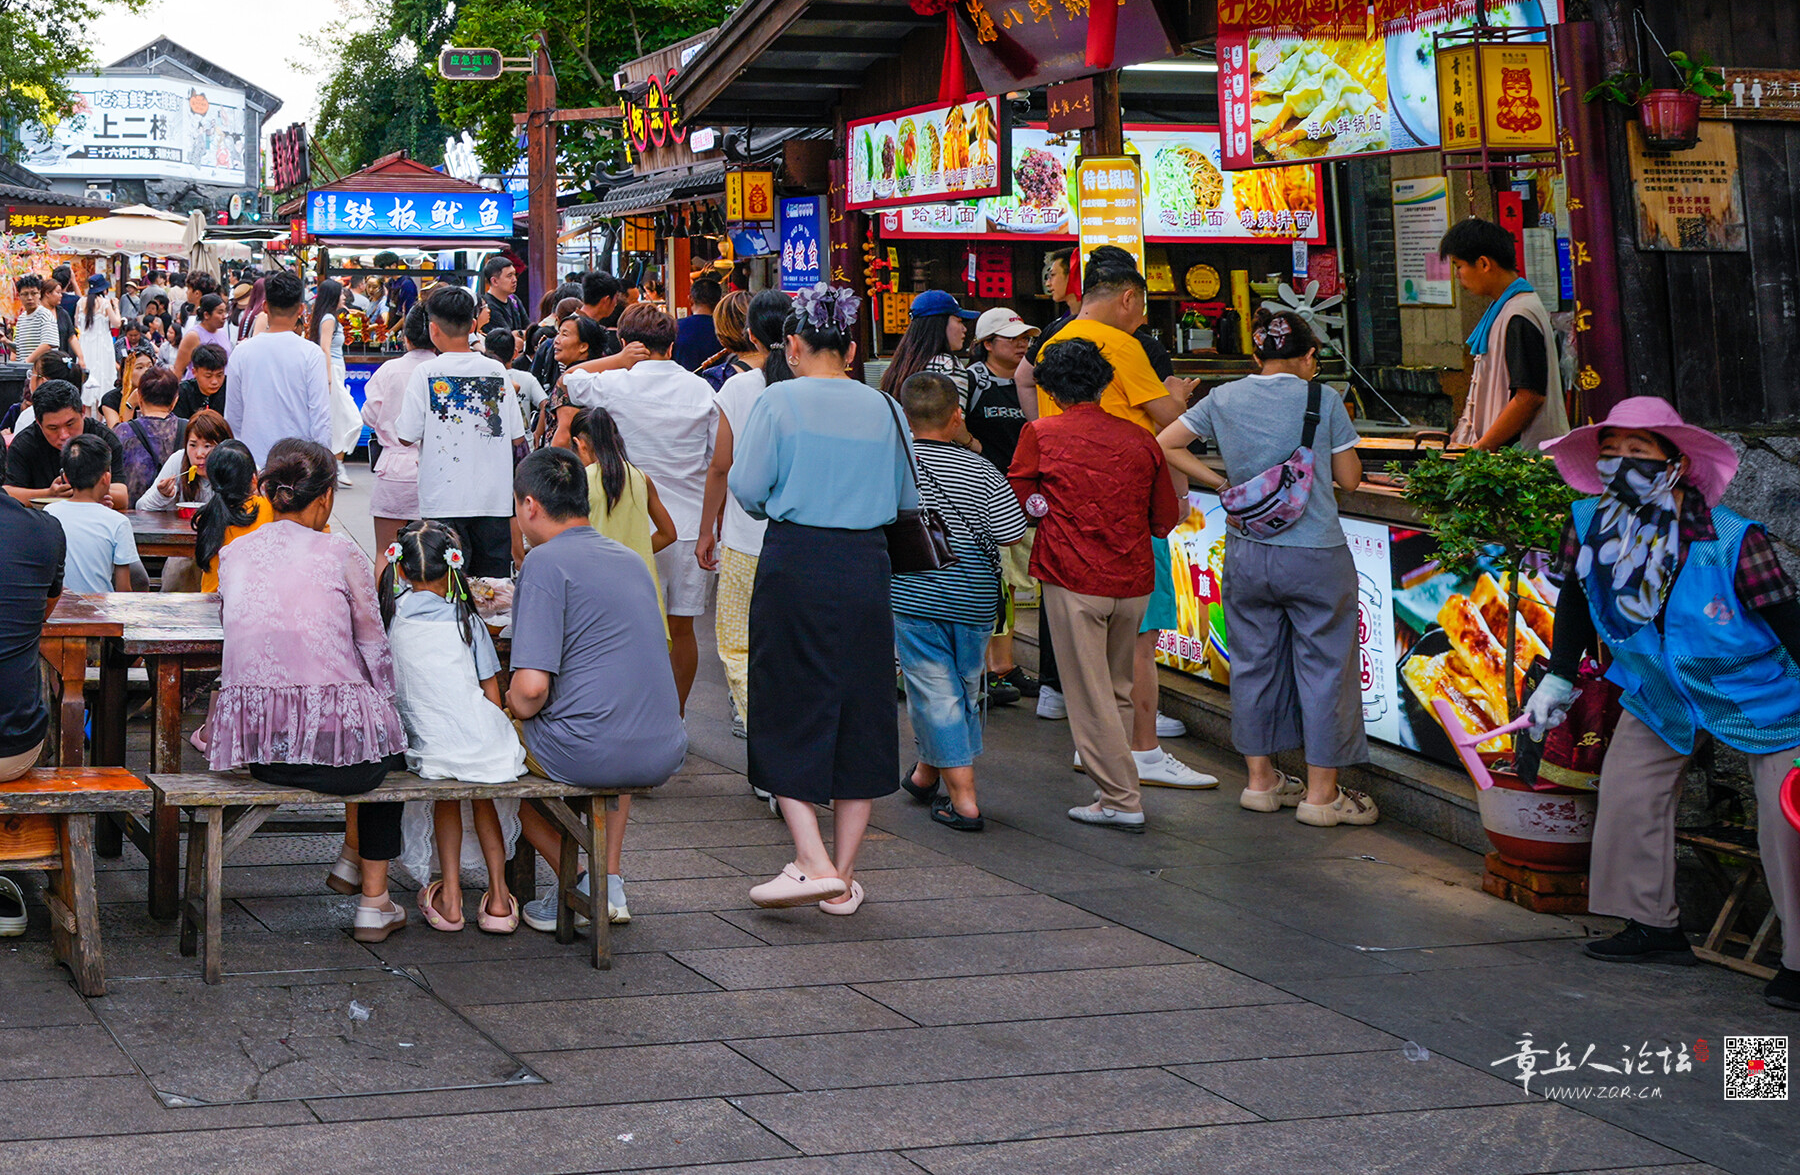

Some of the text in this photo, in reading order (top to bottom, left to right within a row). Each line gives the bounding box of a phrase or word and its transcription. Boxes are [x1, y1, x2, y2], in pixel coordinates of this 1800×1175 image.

[450, 54, 493, 66] 应急疏散
[342, 197, 505, 233] 铁板鱿鱼
[911, 206, 1313, 228] 蛤蜊面 炸酱面 葱油面 麻辣拌面
